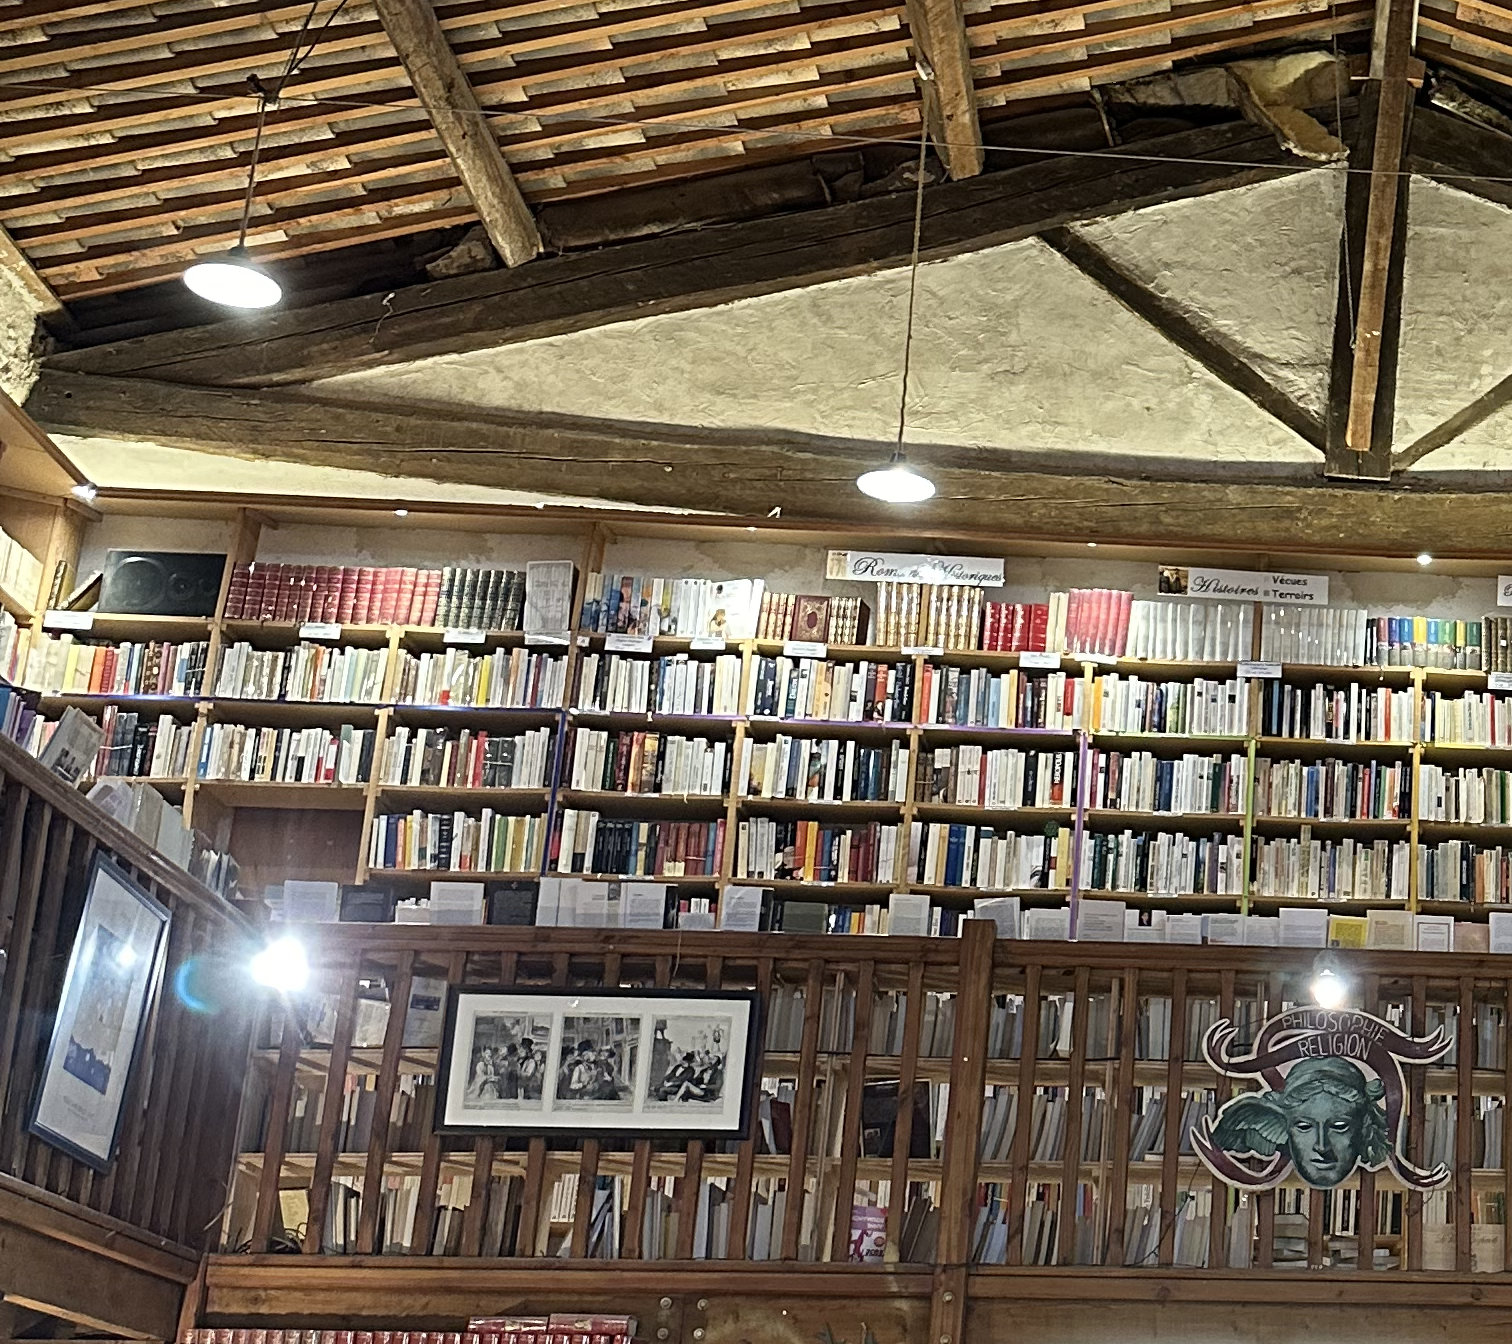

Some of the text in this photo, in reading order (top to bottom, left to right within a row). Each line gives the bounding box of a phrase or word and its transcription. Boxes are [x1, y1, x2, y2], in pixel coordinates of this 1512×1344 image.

[1190, 575, 1260, 596] Histoires
[1271, 589, 1314, 601] Terroirs
[1281, 1011, 1389, 1046] PHILOSOPHIE
[1297, 1033, 1373, 1060] RELIGION
